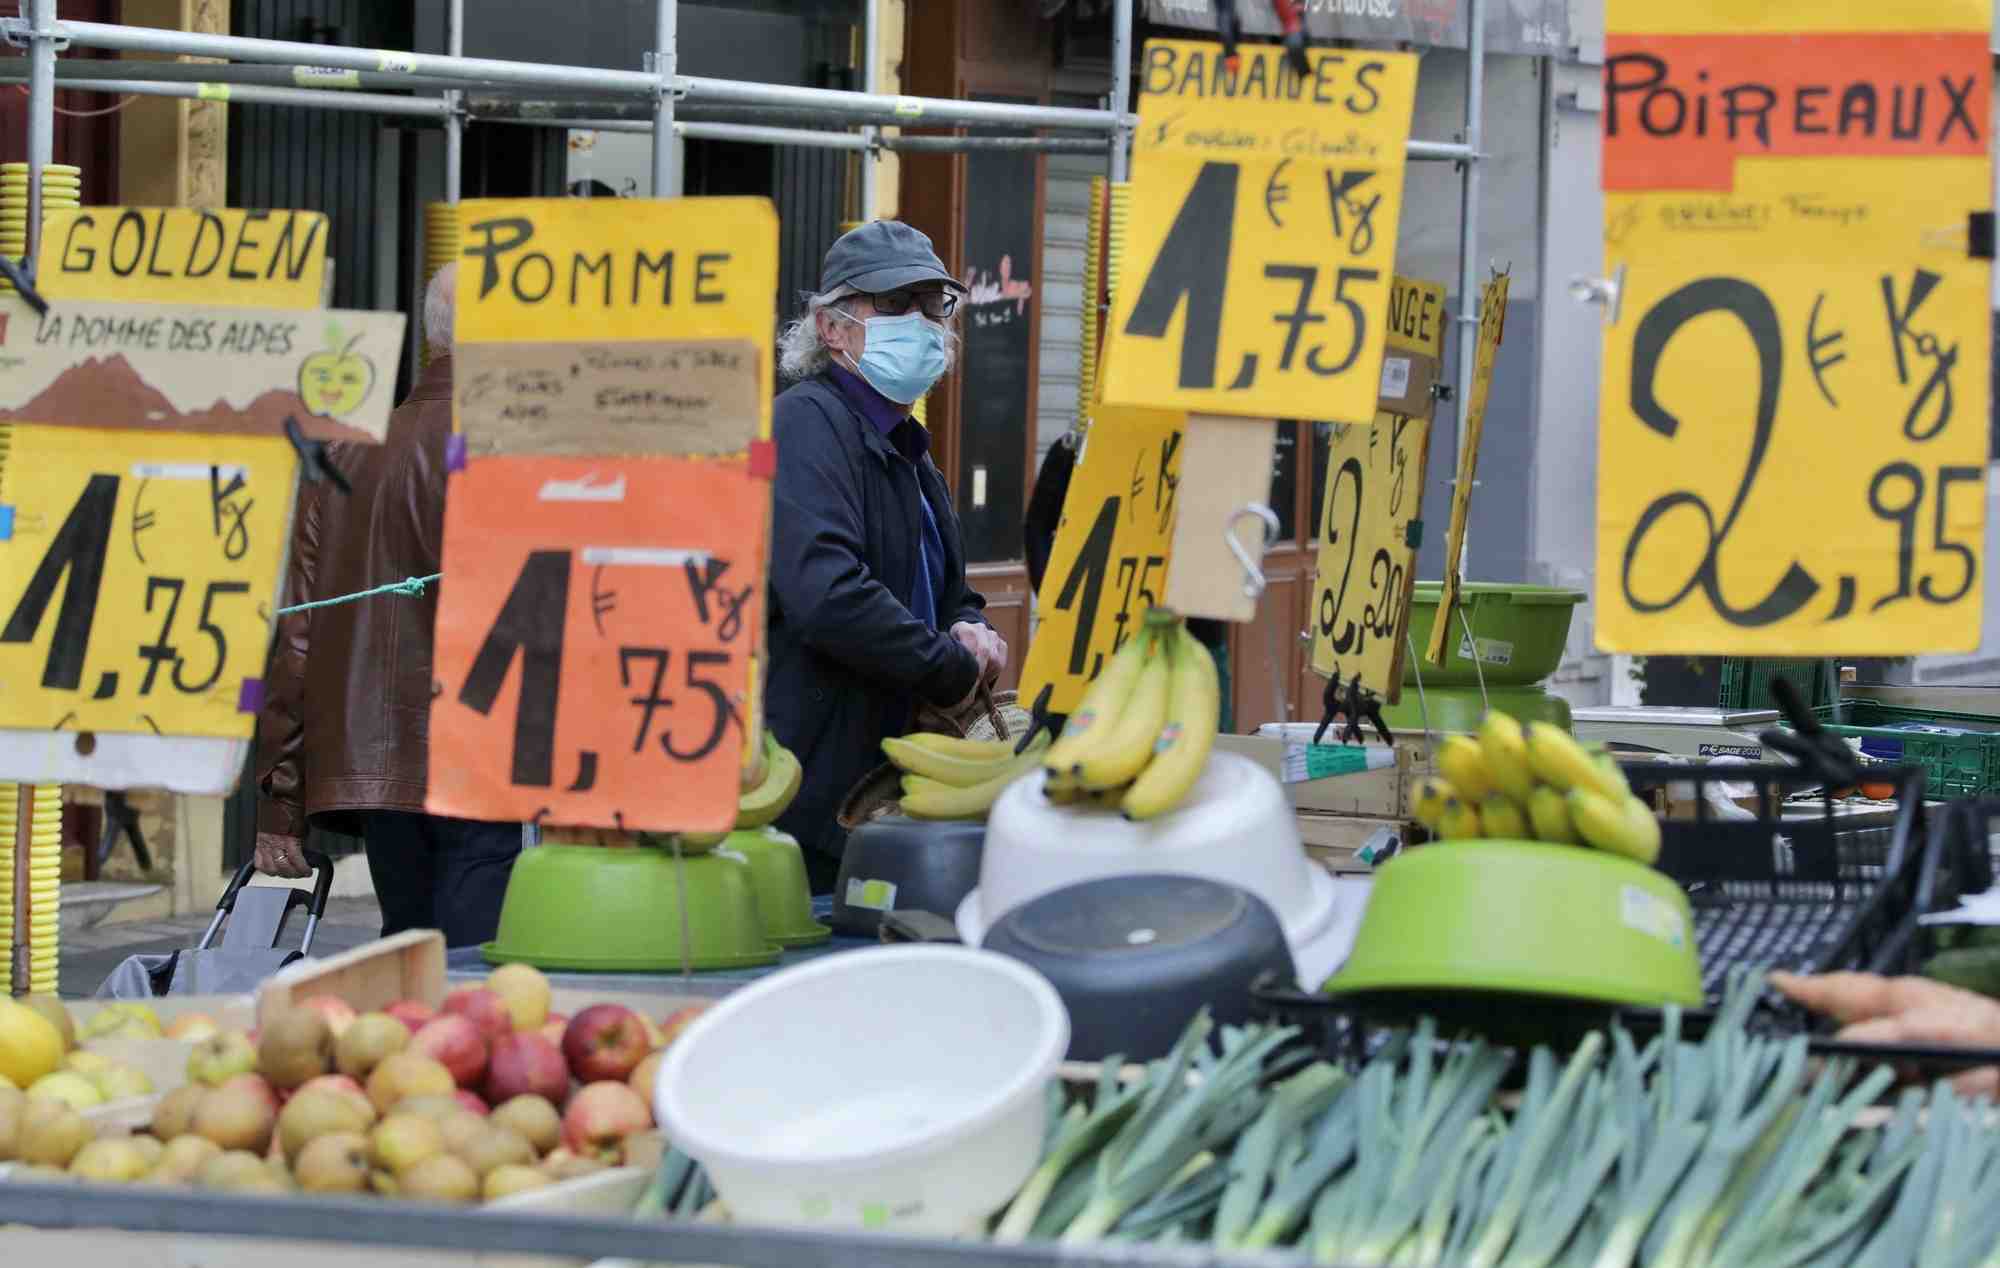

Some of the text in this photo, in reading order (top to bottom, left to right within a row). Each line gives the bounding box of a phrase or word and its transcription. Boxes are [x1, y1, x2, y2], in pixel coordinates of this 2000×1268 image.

[61, 207, 323, 281] GOLDEN
[1326, 168, 1381, 256] Kg
[463, 217, 731, 308] POMME
[36, 313, 298, 357] LA POMME DES ALPES
[1880, 268, 1959, 442] Kg
[210, 465, 254, 561] Kg
[684, 556, 753, 643] Kg
